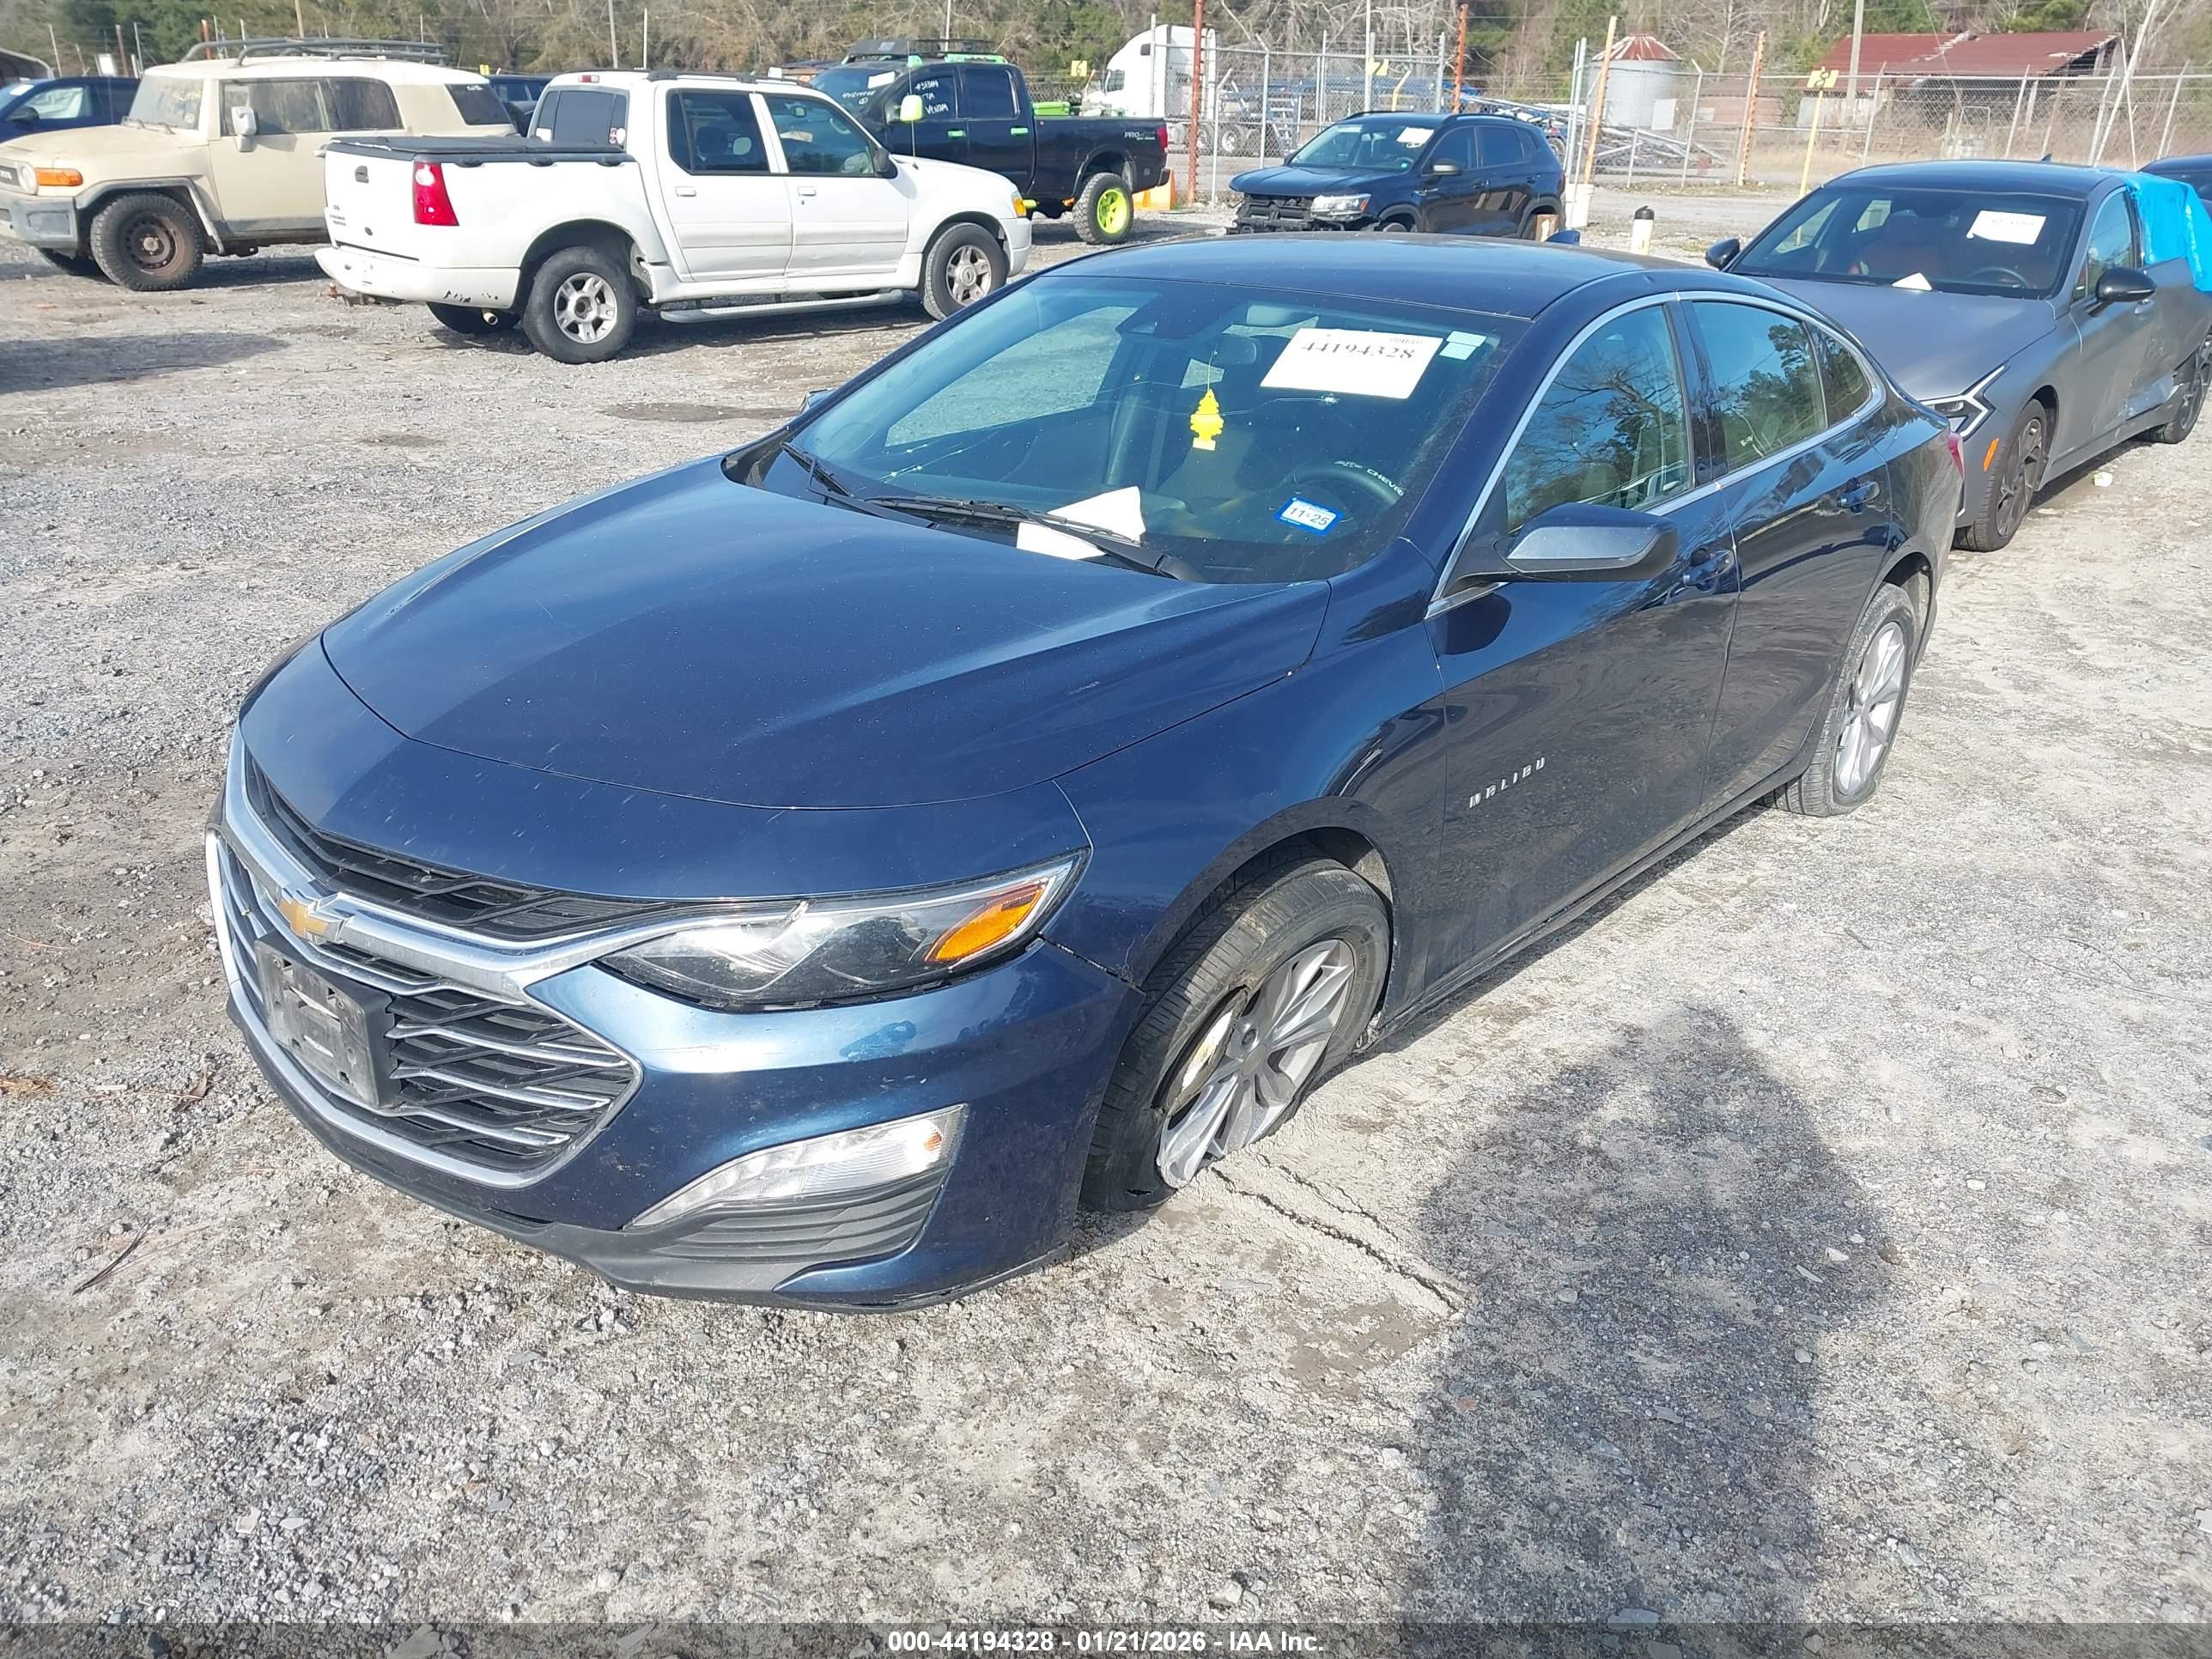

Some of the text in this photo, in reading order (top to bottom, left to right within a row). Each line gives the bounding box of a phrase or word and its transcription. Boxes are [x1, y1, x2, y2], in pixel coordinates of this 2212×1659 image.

[1813, 70, 1832, 88] 8
[1302, 342, 1415, 359] 44194328
[1469, 757, 1546, 808] MALIBU
